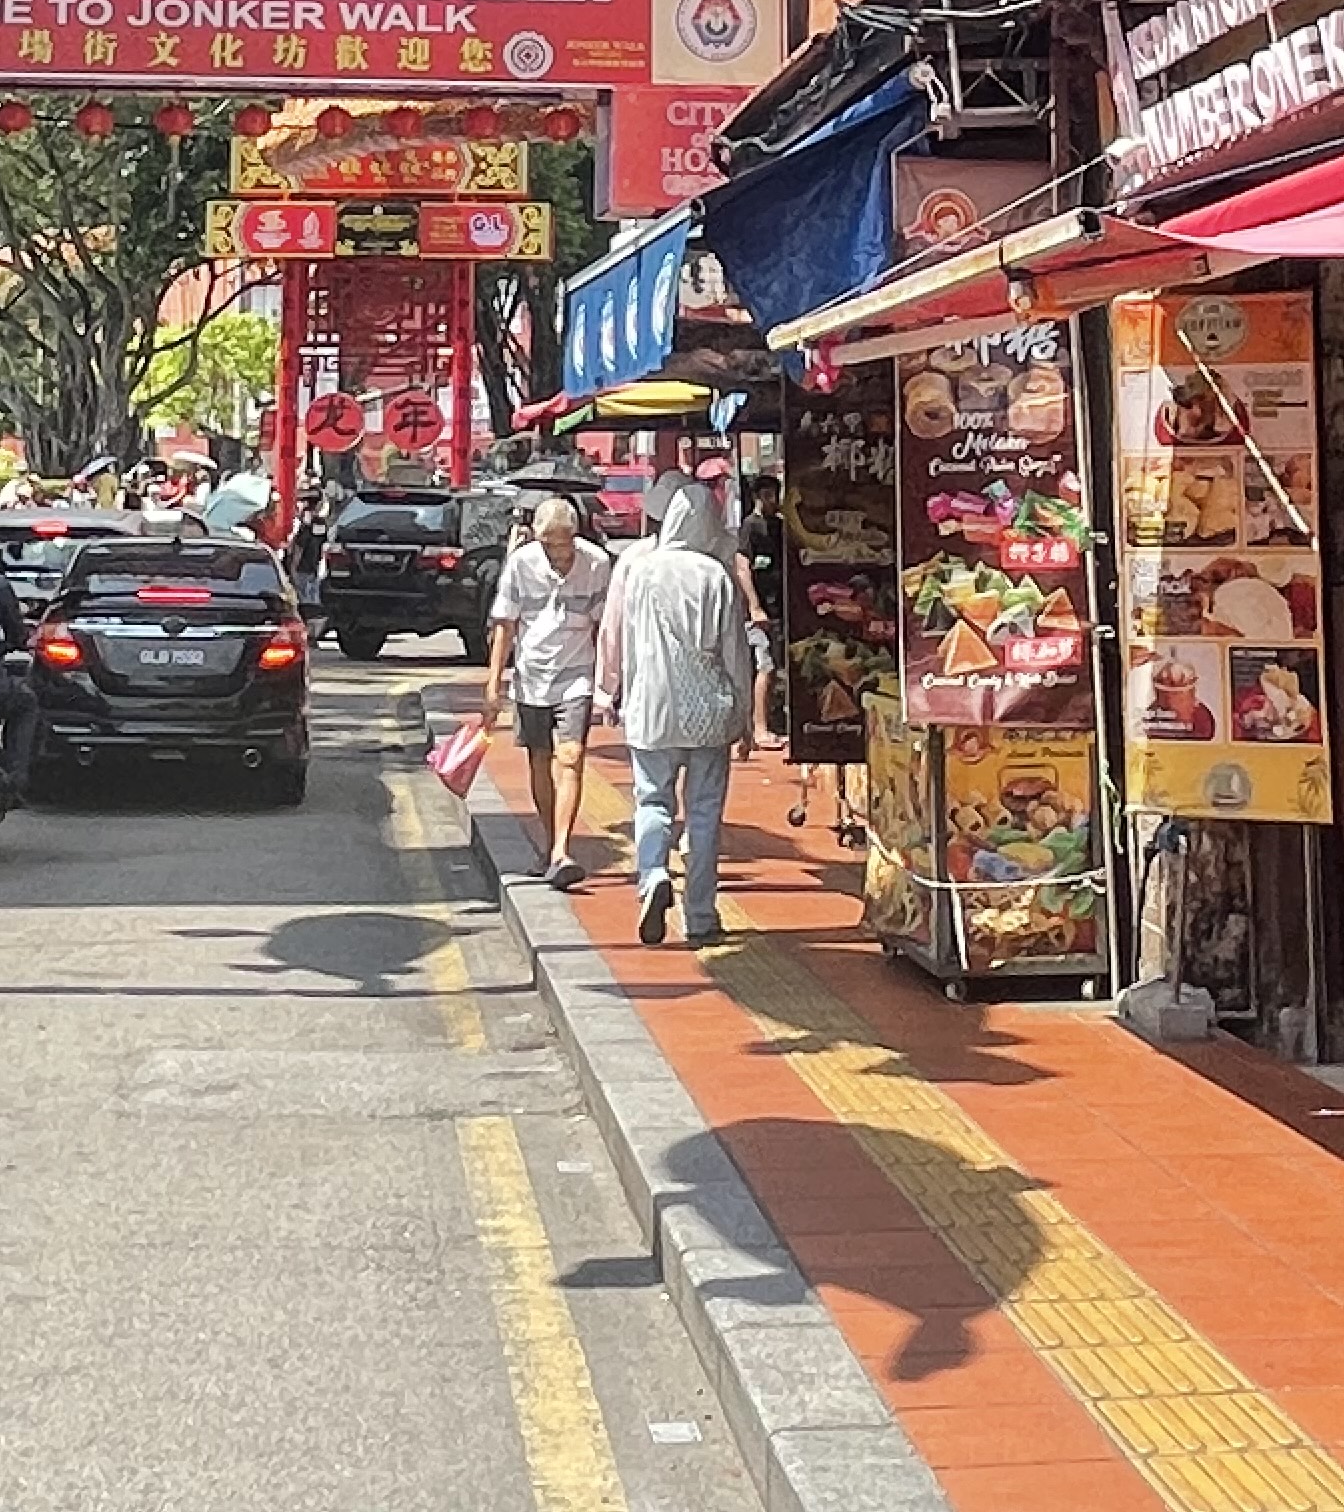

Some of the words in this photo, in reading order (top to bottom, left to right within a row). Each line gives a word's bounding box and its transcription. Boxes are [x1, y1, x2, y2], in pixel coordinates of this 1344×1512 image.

[338, 2, 478, 34] WALK
[1140, 61, 1263, 168] NUMBER
[1250, 24, 1332, 122] ONE
[660, 147, 719, 173] HO
